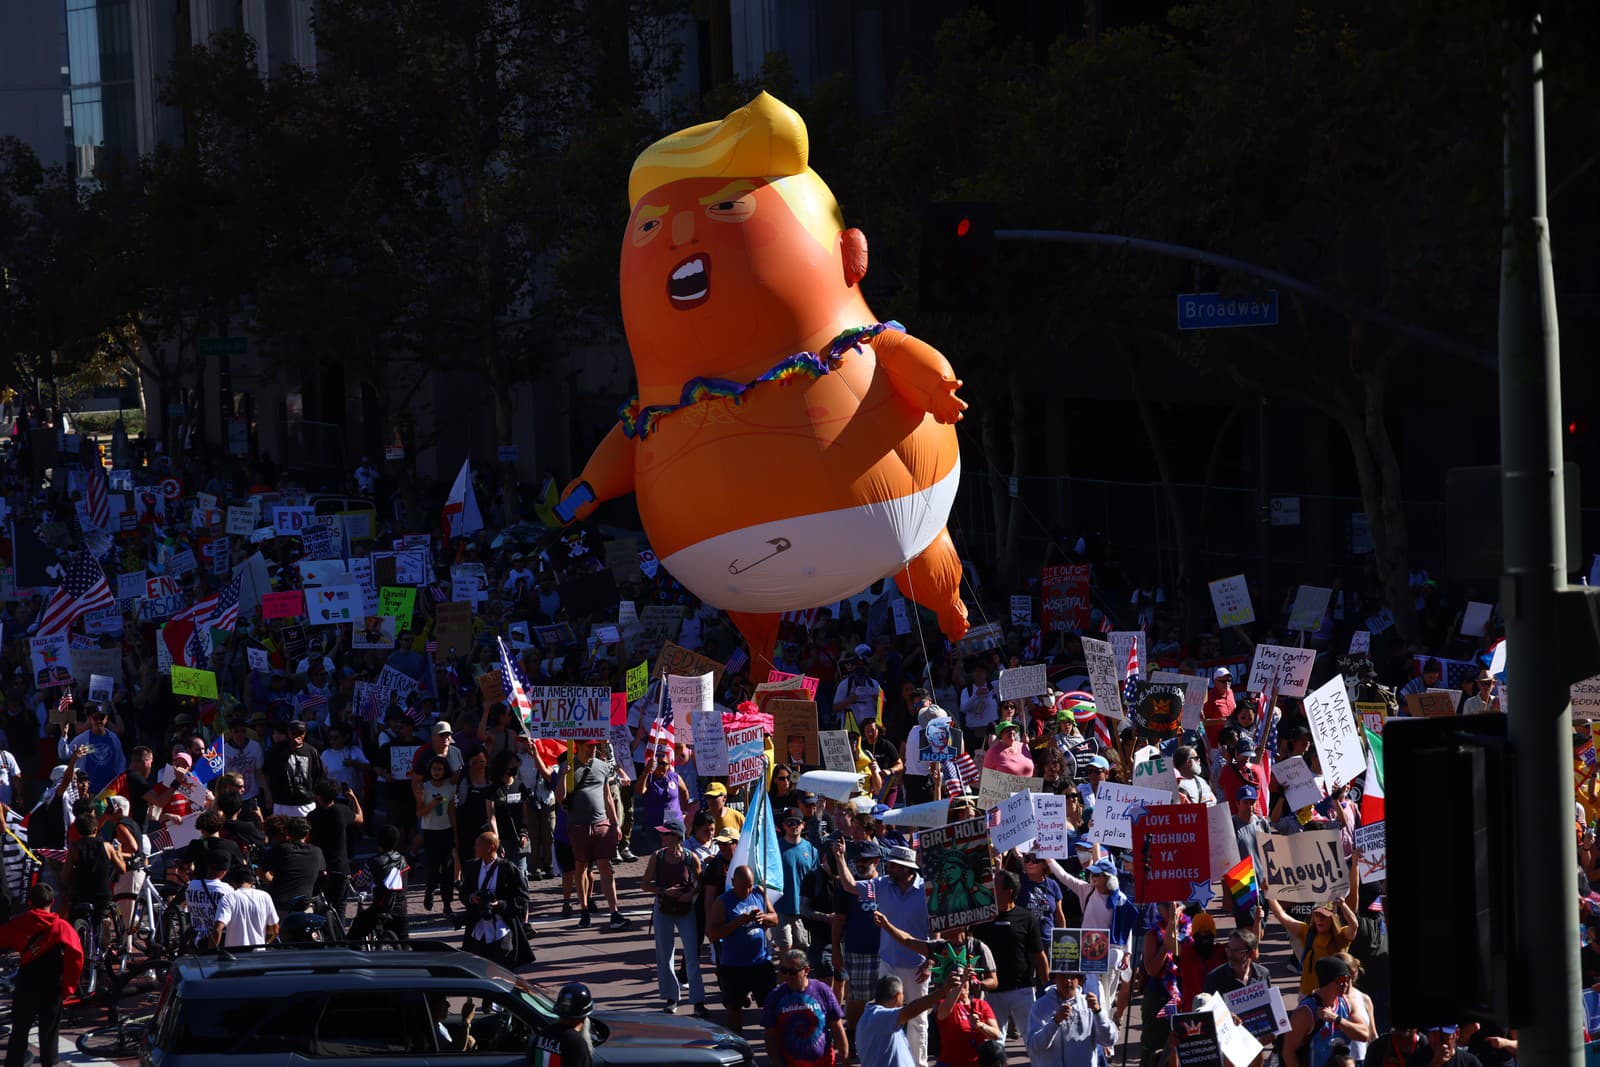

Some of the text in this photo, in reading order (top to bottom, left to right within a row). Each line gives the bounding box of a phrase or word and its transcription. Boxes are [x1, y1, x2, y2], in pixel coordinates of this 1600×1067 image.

[1186, 300, 1270, 320] Broadway
[383, 588, 406, 600] Donald
[1042, 597, 1088, 610] HOSPITAL
[1256, 661, 1296, 672] stans for
[532, 687, 610, 697] AN AMERICA FOR
[532, 698, 609, 721] EVERYONE
[1330, 691, 1352, 737] MAKE
[1310, 697, 1328, 742] THINK
[541, 728, 605, 737] their NIGHTMARE
[1321, 702, 1343, 761] AMERICA
[728, 733, 741, 747] WE
[922, 753, 954, 761] NOPE
[728, 755, 766, 775] DO KINGS
[728, 768, 762, 785] IN AMERIC
[1098, 786, 1112, 801] Life
[1008, 800, 1024, 812] NOT
[1037, 799, 1042, 808] E
[1001, 815, 1017, 828] PAID
[1145, 813, 1198, 826] LOVE THY
[921, 820, 986, 850] GIRL HOLD
[1038, 833, 1053, 842] Stand
[1103, 829, 1126, 843] police
[1144, 833, 1196, 844] EIGHBOR
[1262, 839, 1343, 893] Enough!
[1147, 868, 1200, 881] A##HOLES
[931, 903, 998, 930] MY EARRINGS
[1227, 983, 1264, 1000] IMPEACH
[1231, 990, 1265, 1006] TRUMP
[1191, 1046, 1217, 1055] TRUMP
